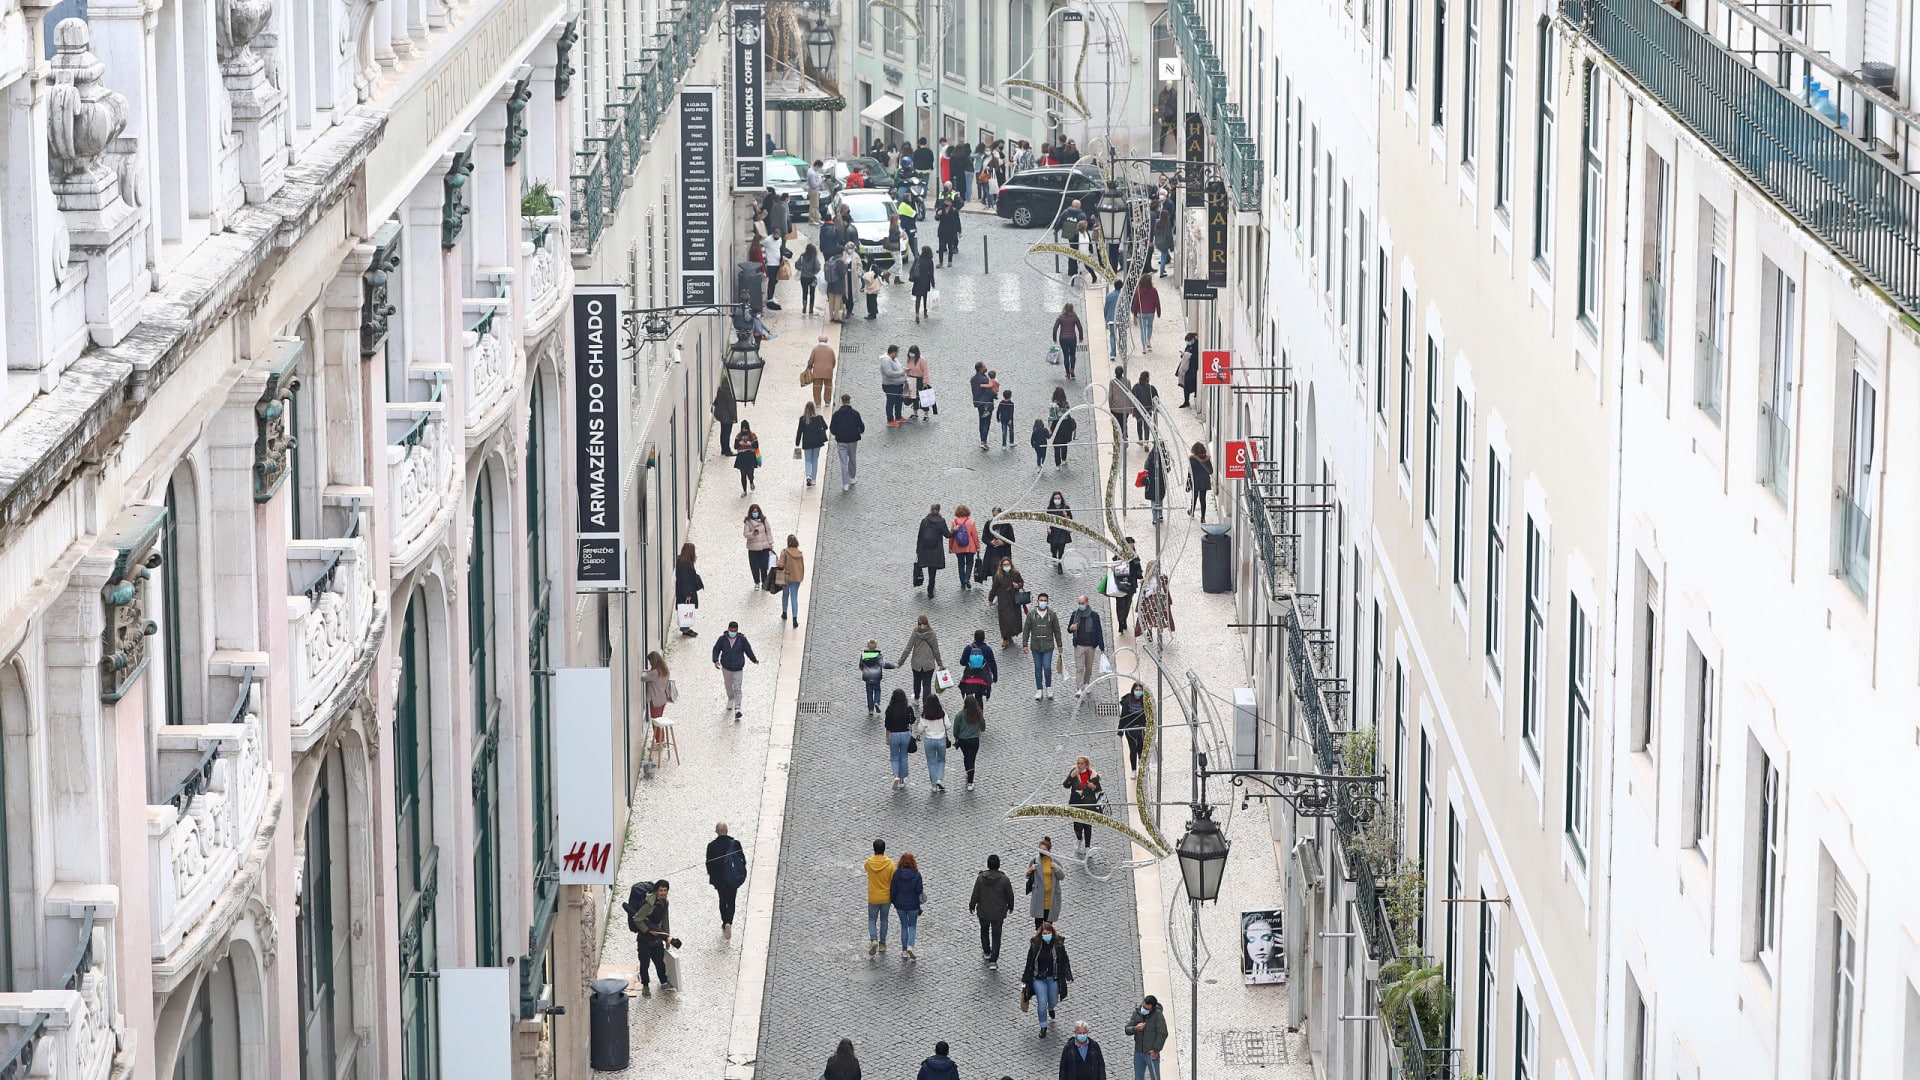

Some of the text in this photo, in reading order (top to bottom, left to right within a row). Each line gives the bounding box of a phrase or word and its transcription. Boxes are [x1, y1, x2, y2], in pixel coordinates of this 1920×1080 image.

[424, 47, 471, 147] EDIFICIO
[744, 48, 754, 147] STARBUCKS COFFEE
[586, 300, 606, 527] ARMAZÉNS DO CHIADO
[563, 841, 612, 874] H&M
